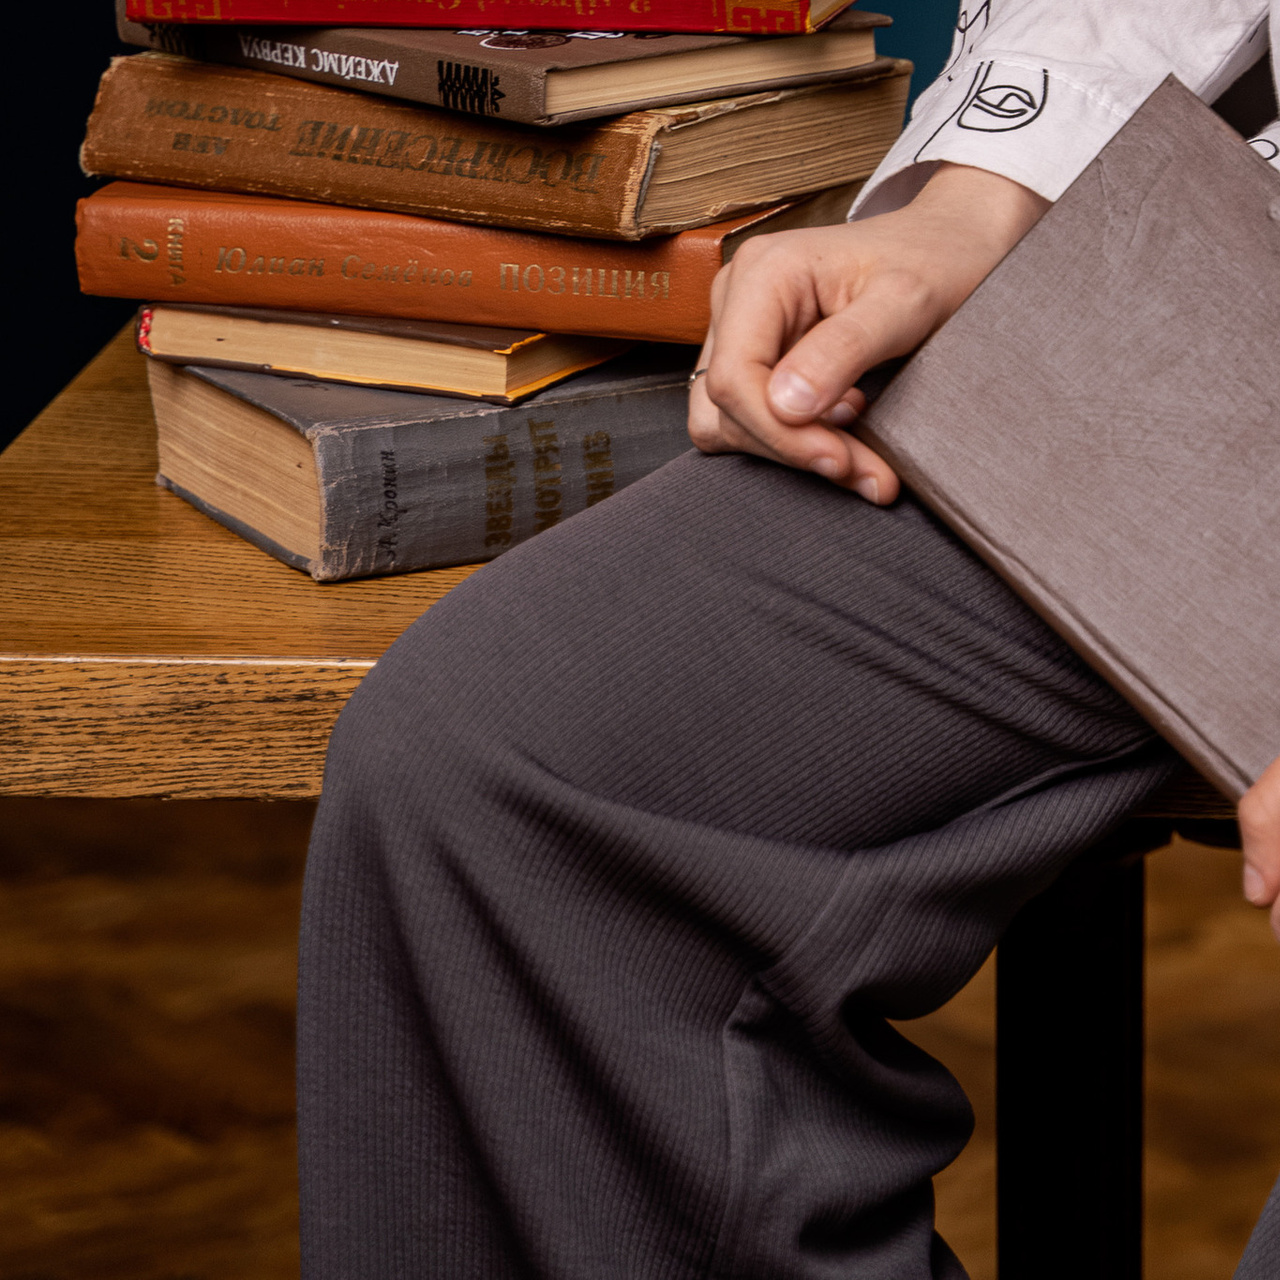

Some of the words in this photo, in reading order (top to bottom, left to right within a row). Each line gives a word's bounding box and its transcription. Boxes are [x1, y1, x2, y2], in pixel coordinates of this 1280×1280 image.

[239, 31, 308, 66] КЕРВУД
[311, 47, 400, 86] ДЖЕЙМС
[144, 96, 283, 132] ТОЛСТОЙ
[171, 132, 232, 155] ЛЕВ
[288, 119, 608, 194] ВОСКРЕСЕНИЕ
[118, 237, 160, 263] 2
[167, 217, 187, 287] КНИГА
[214, 246, 326, 277] Юлиан
[340, 254, 474, 288] Семёнов
[499, 261, 671, 300] ПОЗИЦИЯ
[483, 433, 518, 547] ЗВЕЗДЫ
[527, 417, 563, 533] МОТРЯТ
